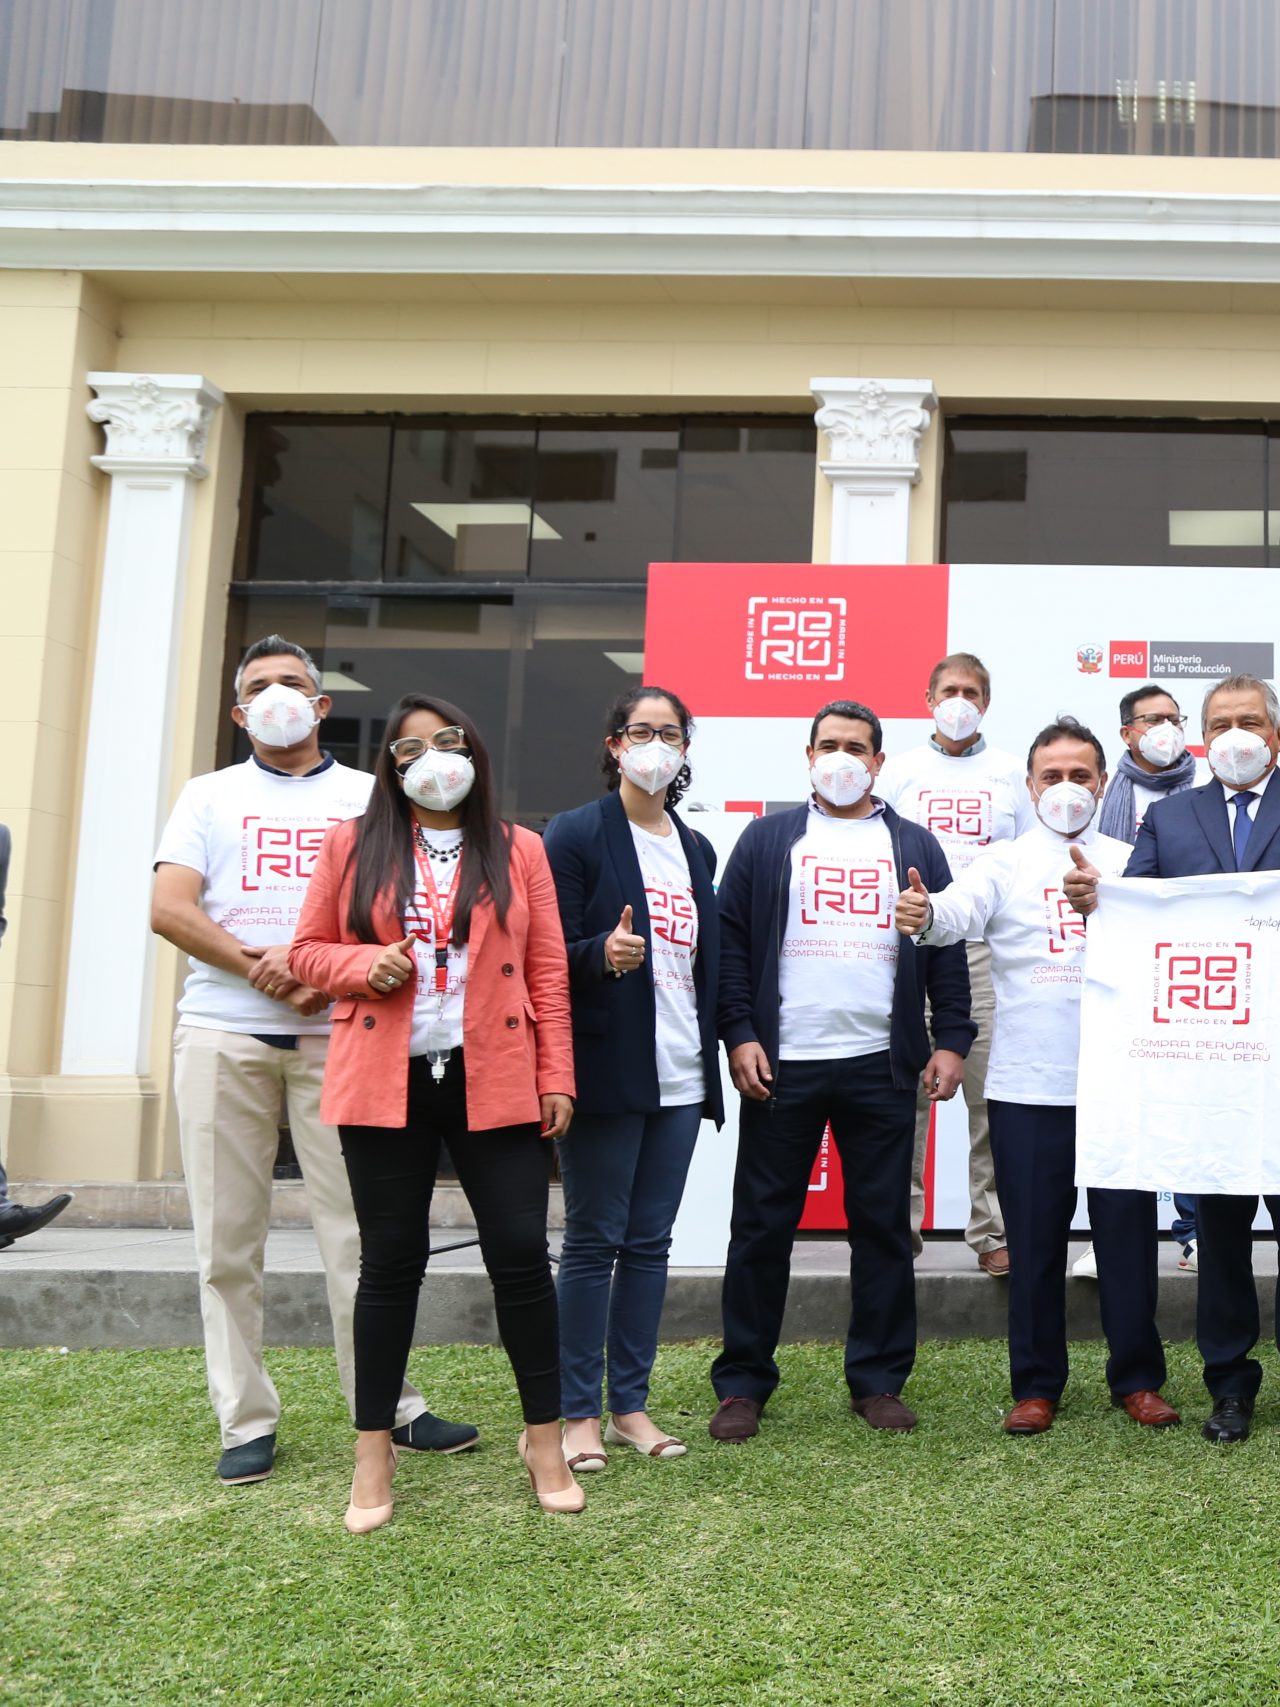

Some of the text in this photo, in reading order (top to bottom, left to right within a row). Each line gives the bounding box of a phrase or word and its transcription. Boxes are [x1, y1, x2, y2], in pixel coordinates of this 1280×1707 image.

[746, 618, 755, 658] MADE IN
[837, 619, 846, 659] MADE IN
[1113, 653, 1144, 665] PERÚ
[1153, 654, 1202, 664] Ministerio
[1153, 664, 1231, 674] de la Producción
[223, 907, 282, 917] COMPRA
[784, 939, 838, 948] COMPRA
[858, 951, 873, 960] AL
[877, 953, 898, 962] PER
[1034, 965, 1081, 974] COMPRA
[1154, 963, 1160, 972] IN
[1245, 994, 1250, 1003] IN
[1133, 1038, 1190, 1048] COMPRA
[1209, 1053, 1227, 1061] AL
